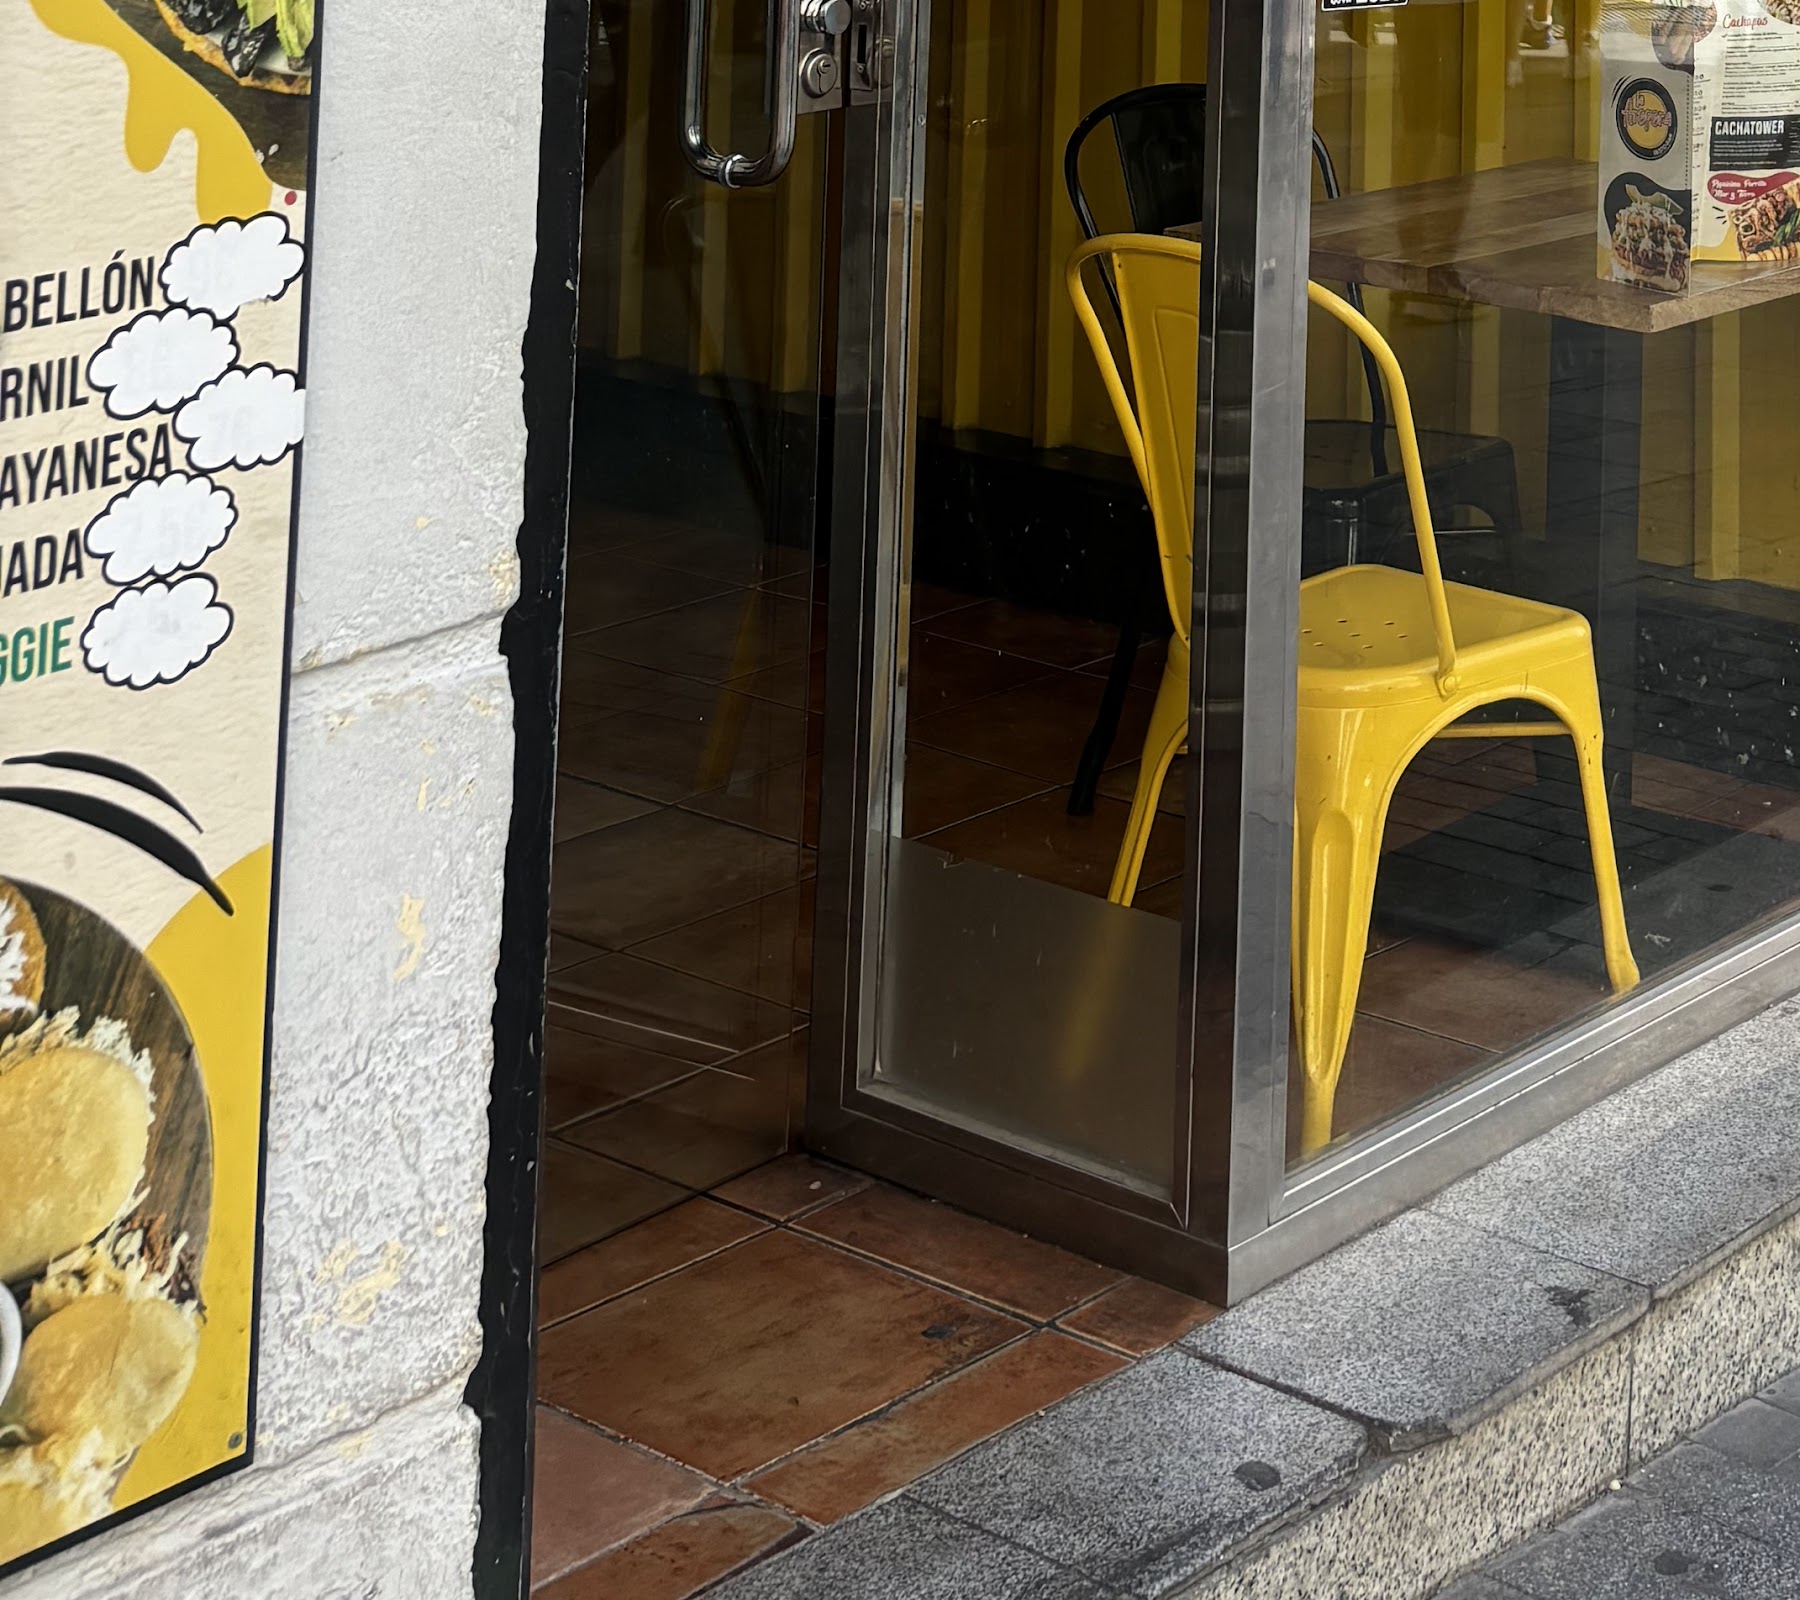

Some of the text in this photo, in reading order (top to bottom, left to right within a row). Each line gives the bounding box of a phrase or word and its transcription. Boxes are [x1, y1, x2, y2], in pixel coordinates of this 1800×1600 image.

[1722, 14, 1768, 31] Cachapas
[1715, 119, 1785, 136] CACHATOWER
[2, 250, 155, 333] BELLÓN
